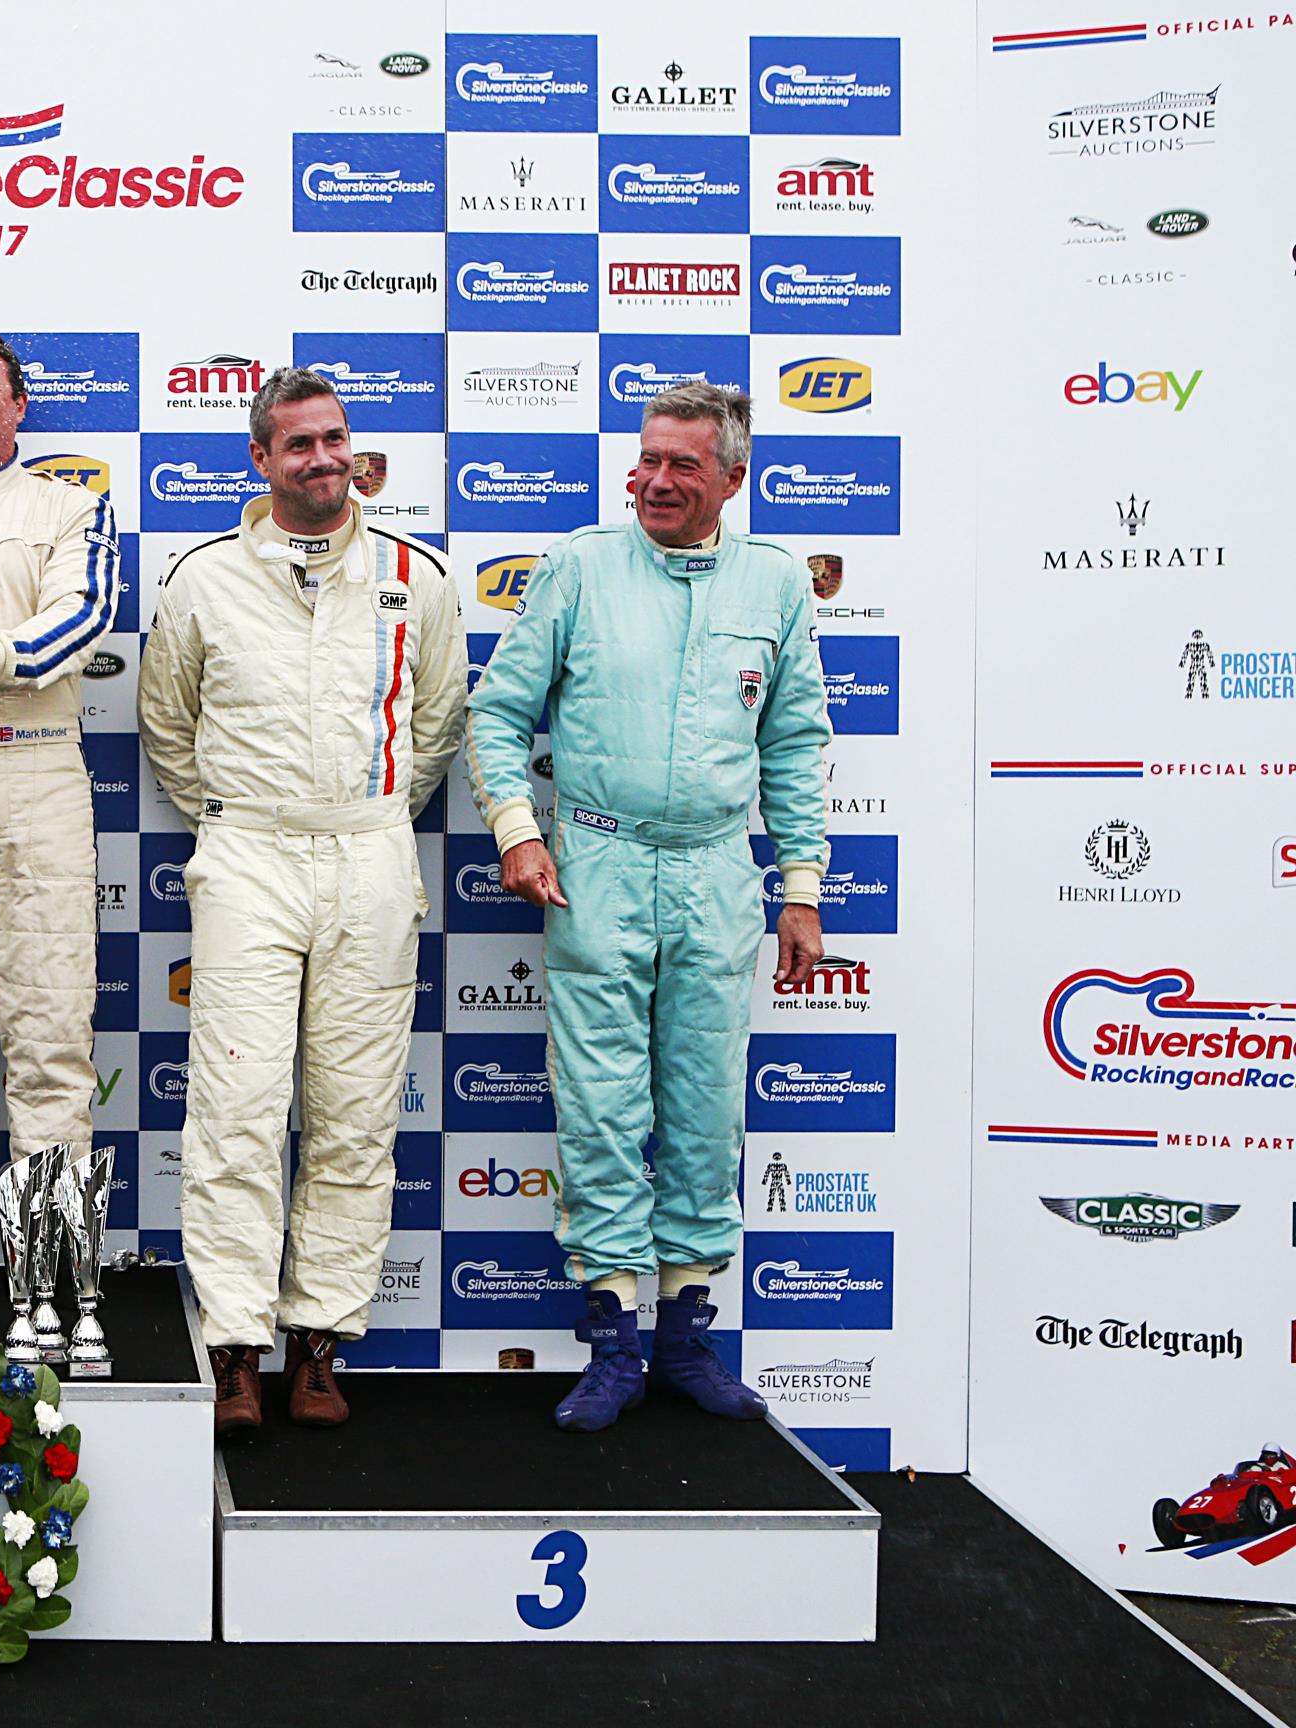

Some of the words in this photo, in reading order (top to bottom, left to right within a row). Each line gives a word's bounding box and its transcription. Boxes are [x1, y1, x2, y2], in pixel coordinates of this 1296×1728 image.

[1157, 17, 1255, 36] OFFICIAL
[387, 64, 421, 74] ROVER
[471, 80, 588, 95] SilverstoneClassic
[775, 83, 891, 97] SilverstoneClassic
[612, 86, 736, 105] GALLET
[340, 106, 403, 116] CLASSIC
[1048, 110, 1215, 139] SILVERSTONE
[1079, 137, 1184, 157] AUCTIONS
[318, 180, 435, 195] SilverstoneClassic
[777, 164, 874, 197] amt
[624, 181, 740, 196] SilverstoneClassic
[460, 197, 587, 211] MASERATI
[777, 202, 806, 211] rent.
[809, 200, 846, 211] lease.
[849, 200, 874, 213] buy.
[1157, 222, 1199, 233] ROVER
[1062, 236, 1127, 245] JAGUAR
[301, 269, 340, 292] The
[343, 269, 437, 294] Telegraph
[612, 266, 681, 291] PLANET
[686, 268, 736, 291] ROCK
[1097, 271, 1174, 285] CLASSIC
[472, 280, 589, 295] SilverstoneClassic
[775, 282, 891, 297] SilverstoneClassic
[167, 365, 265, 393] amt
[463, 377, 579, 392] SILVERSTONE
[789, 372, 862, 398] JET
[1064, 362, 1202, 411] ebay
[167, 399, 195, 408] rent.
[200, 398, 238, 408] lease.
[485, 397, 558, 406] AUCTIONS
[165, 481, 271, 495] SilverstoneClass
[473, 480, 589, 494] SilverstoneClassic
[774, 483, 891, 498] SilverstoneClassic
[1043, 547, 1226, 570] MASERATI
[380, 595, 407, 607] OMP
[1221, 652, 1296, 676] PROSTAT
[1221, 676, 1296, 699] CANCER
[16, 730, 40, 739] Mark
[1151, 764, 1247, 776] OFFICIAL
[206, 801, 223, 815] OMP
[575, 809, 616, 829] sparco
[1058, 886, 1115, 902] HENRI
[1121, 887, 1182, 903] LLOYD
[773, 1000, 801, 1009] rent.
[806, 999, 841, 1009] lease.
[844, 999, 870, 1012] buy.
[1093, 1024, 1296, 1060] Silverston
[771, 1080, 886, 1094] SilverstoneClassic
[1167, 1134, 1231, 1148] MEDIA
[796, 1172, 870, 1192] PROSTATE
[796, 1193, 853, 1213] CANCER
[857, 1193, 876, 1213] UK
[1078, 1200, 1201, 1228] CLASSIC
[1115, 1226, 1150, 1234] SPORTS
[1152, 1227, 1173, 1236] CAR
[467, 1278, 583, 1291] SilverstoneClassic
[768, 1279, 884, 1292] SilverstoneClassic
[1035, 1315, 1093, 1350] The
[1099, 1318, 1243, 1359] Telegraph
[758, 1373, 872, 1389] SILVERSTONE
[779, 1392, 852, 1402] AUCTIONS
[1188, 1496, 1213, 1509] 27
[516, 1529, 588, 1630] 3
